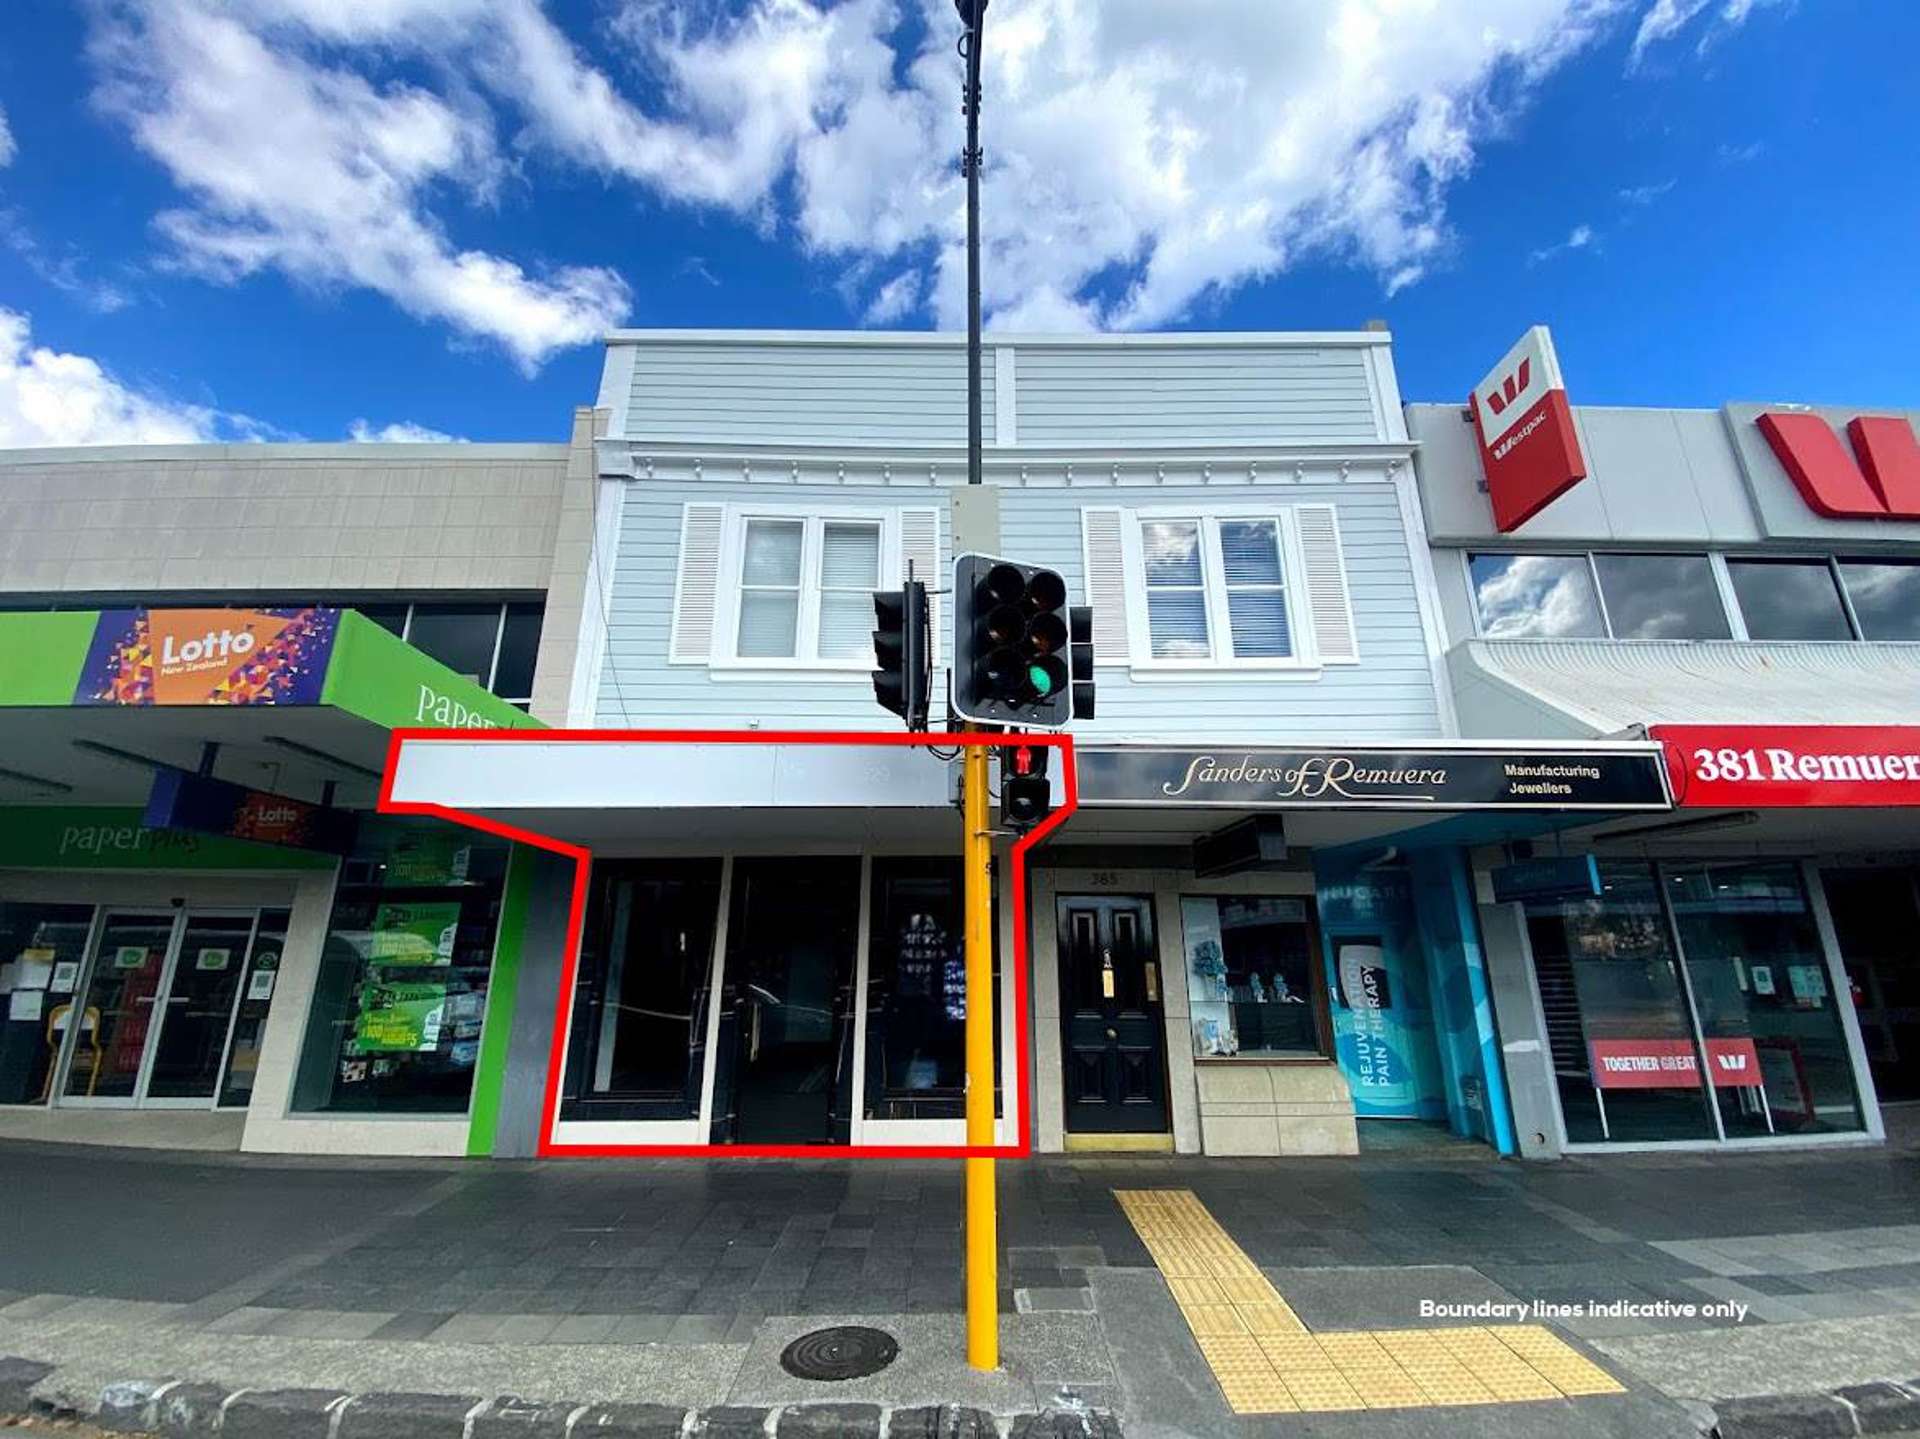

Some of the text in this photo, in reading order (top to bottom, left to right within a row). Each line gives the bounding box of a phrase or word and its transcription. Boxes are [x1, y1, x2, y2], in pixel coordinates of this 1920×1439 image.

[1493, 410, 1547, 460] Westpac
[162, 629, 255, 665] Lotto
[161, 656, 228, 677] New Zealand
[1162, 755, 1447, 800] Sanders of Remuera
[1504, 764, 1600, 779] Manufacturing
[1693, 748, 1920, 782] 381 Remuer
[1509, 781, 1572, 794] Jewellers
[258, 806, 297, 822] Lotto
[1361, 965, 1392, 1087] PAIN THERAPY
[1602, 1055, 1659, 1072] TOGETHER
